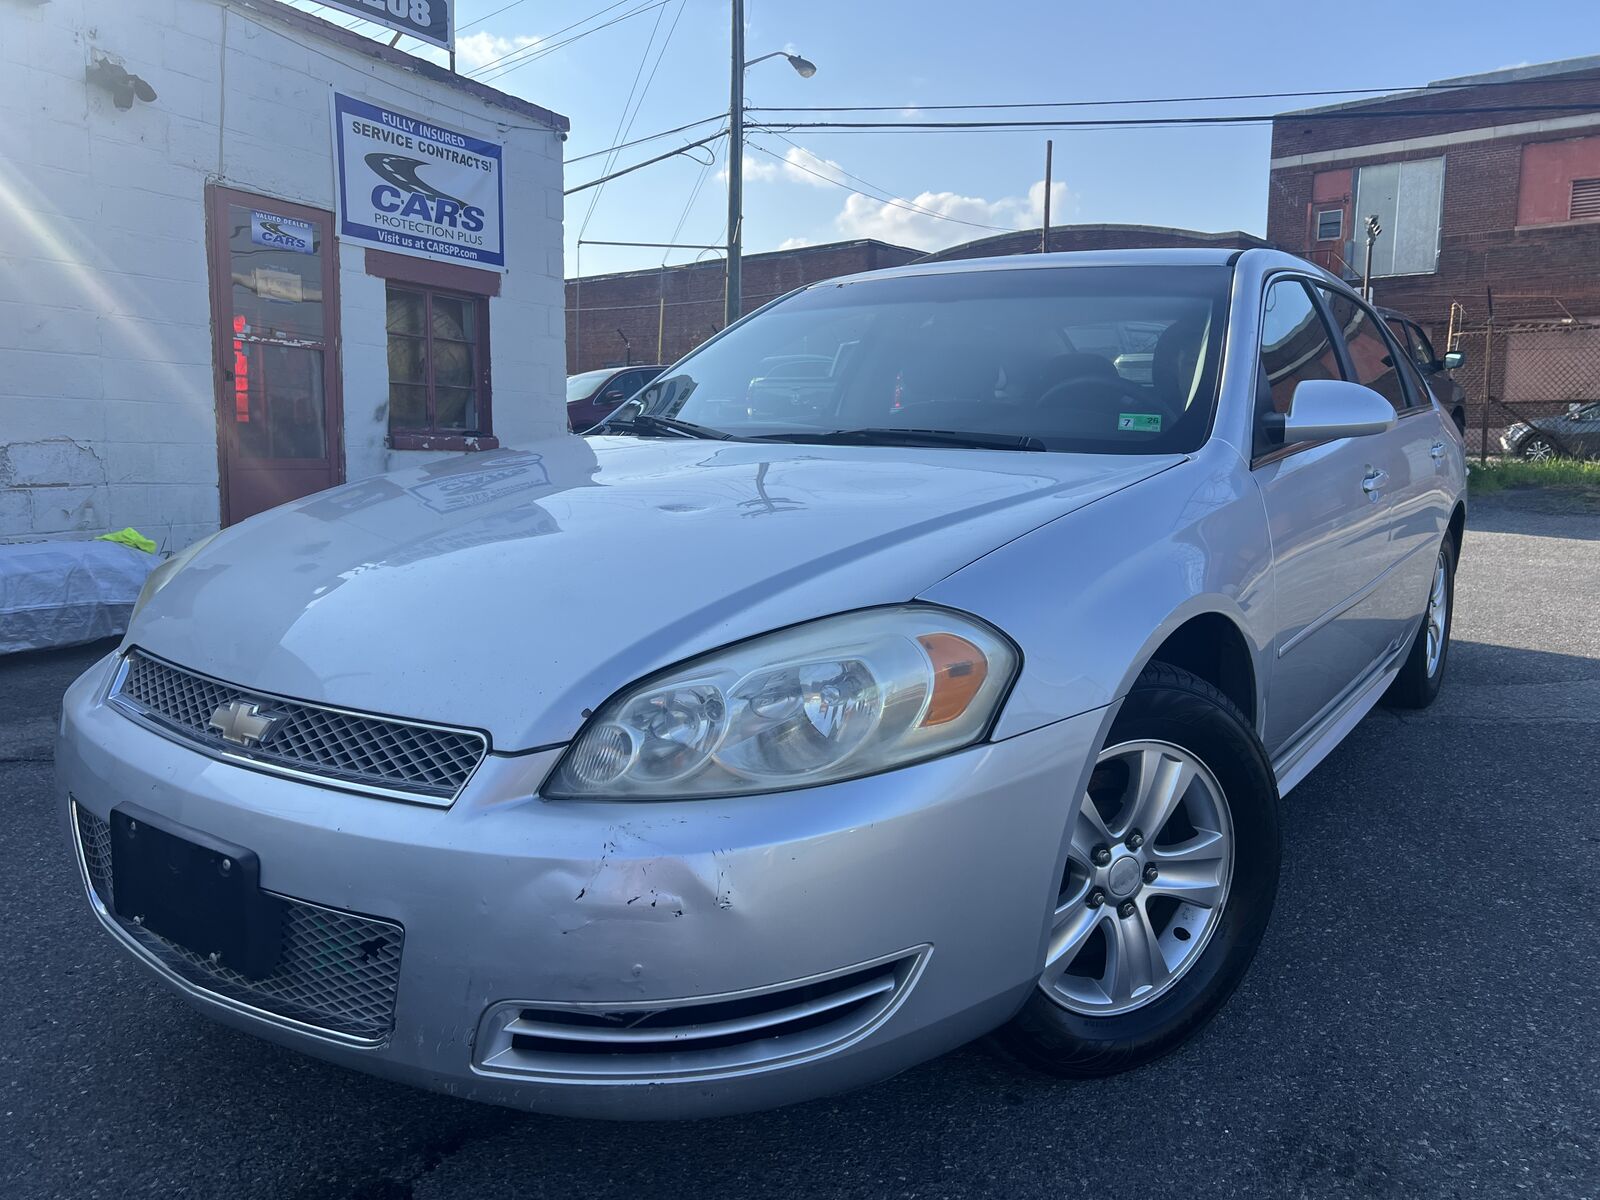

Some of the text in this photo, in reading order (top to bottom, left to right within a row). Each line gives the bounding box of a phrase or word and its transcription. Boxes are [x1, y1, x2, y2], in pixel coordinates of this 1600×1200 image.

[382, 112, 466, 147] FULLY INSURED
[352, 121, 492, 172] SERVICE CONTRACTS!
[255, 212, 309, 229] VALUED DEALER
[374, 213, 483, 246] PROTECTION PLUS
[261, 232, 306, 248] CARS
[378, 230, 478, 260] Visit us at CARSPP.com
[1124, 418, 1131, 427] 7
